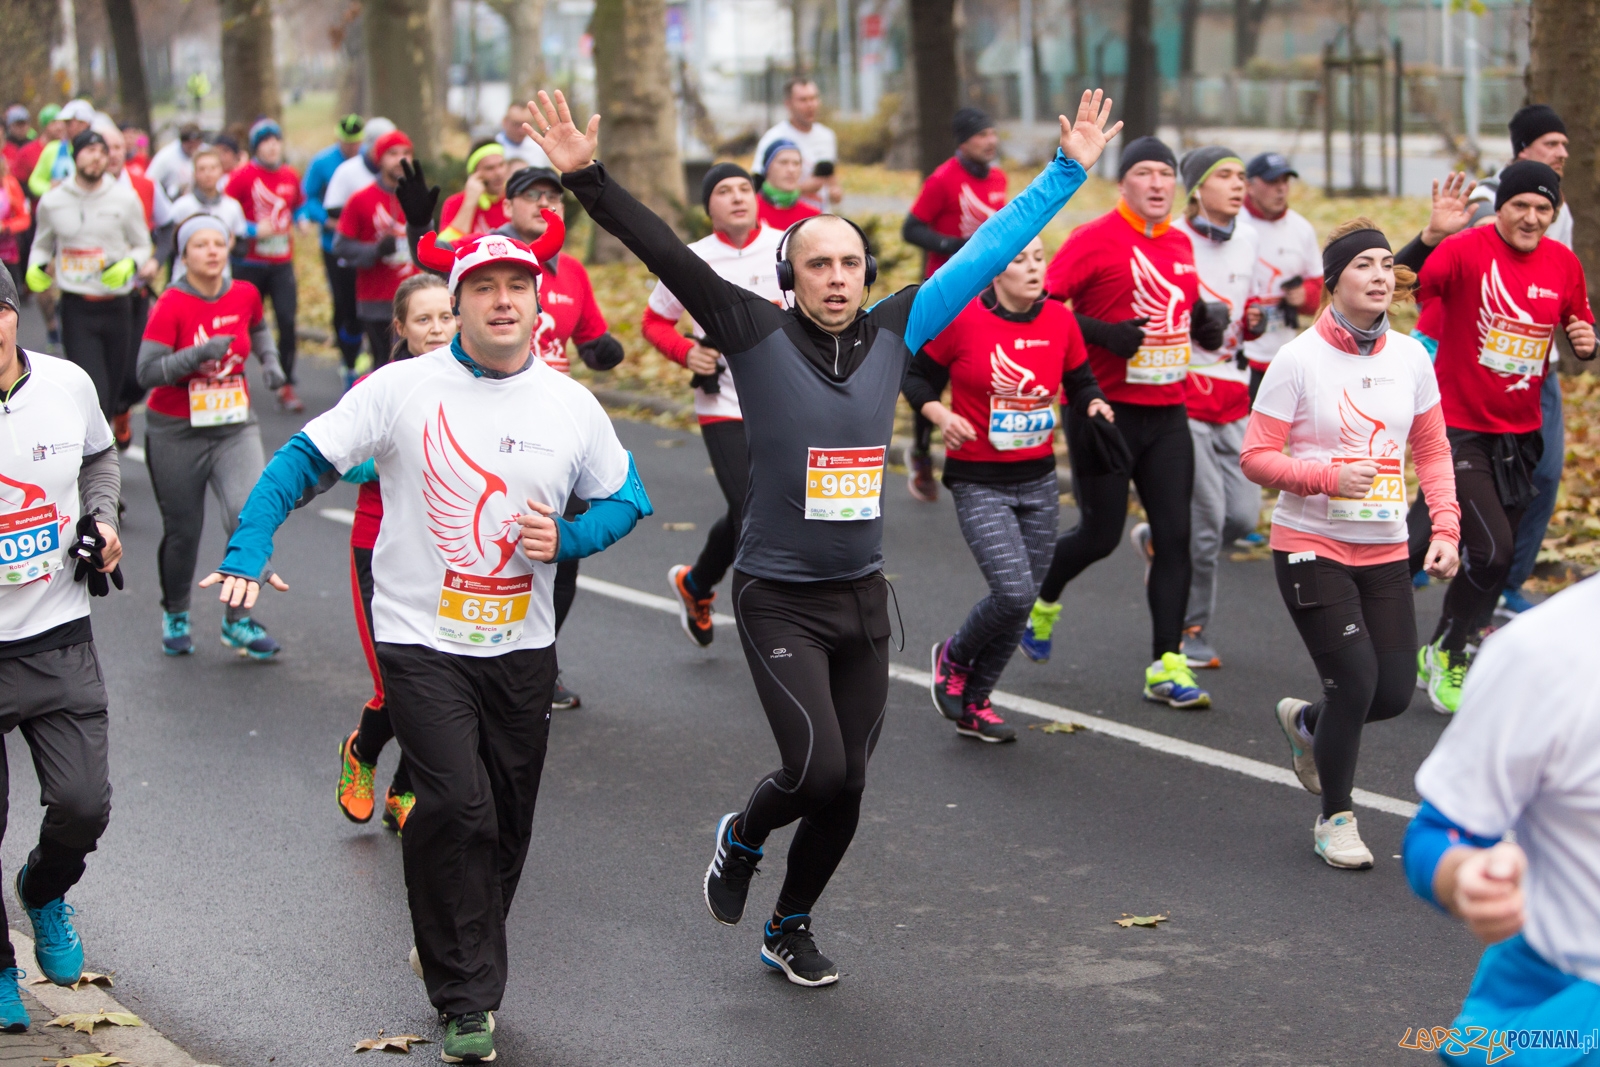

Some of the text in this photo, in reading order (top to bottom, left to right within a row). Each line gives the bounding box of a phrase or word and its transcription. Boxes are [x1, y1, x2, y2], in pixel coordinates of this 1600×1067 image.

[1495, 335, 1542, 358] 9151
[1138, 348, 1186, 367] 3862
[1000, 412, 1048, 432] 4877
[810, 471, 881, 496] D 9694
[9, 561, 30, 571] Robert
[441, 598, 514, 623] D 651
